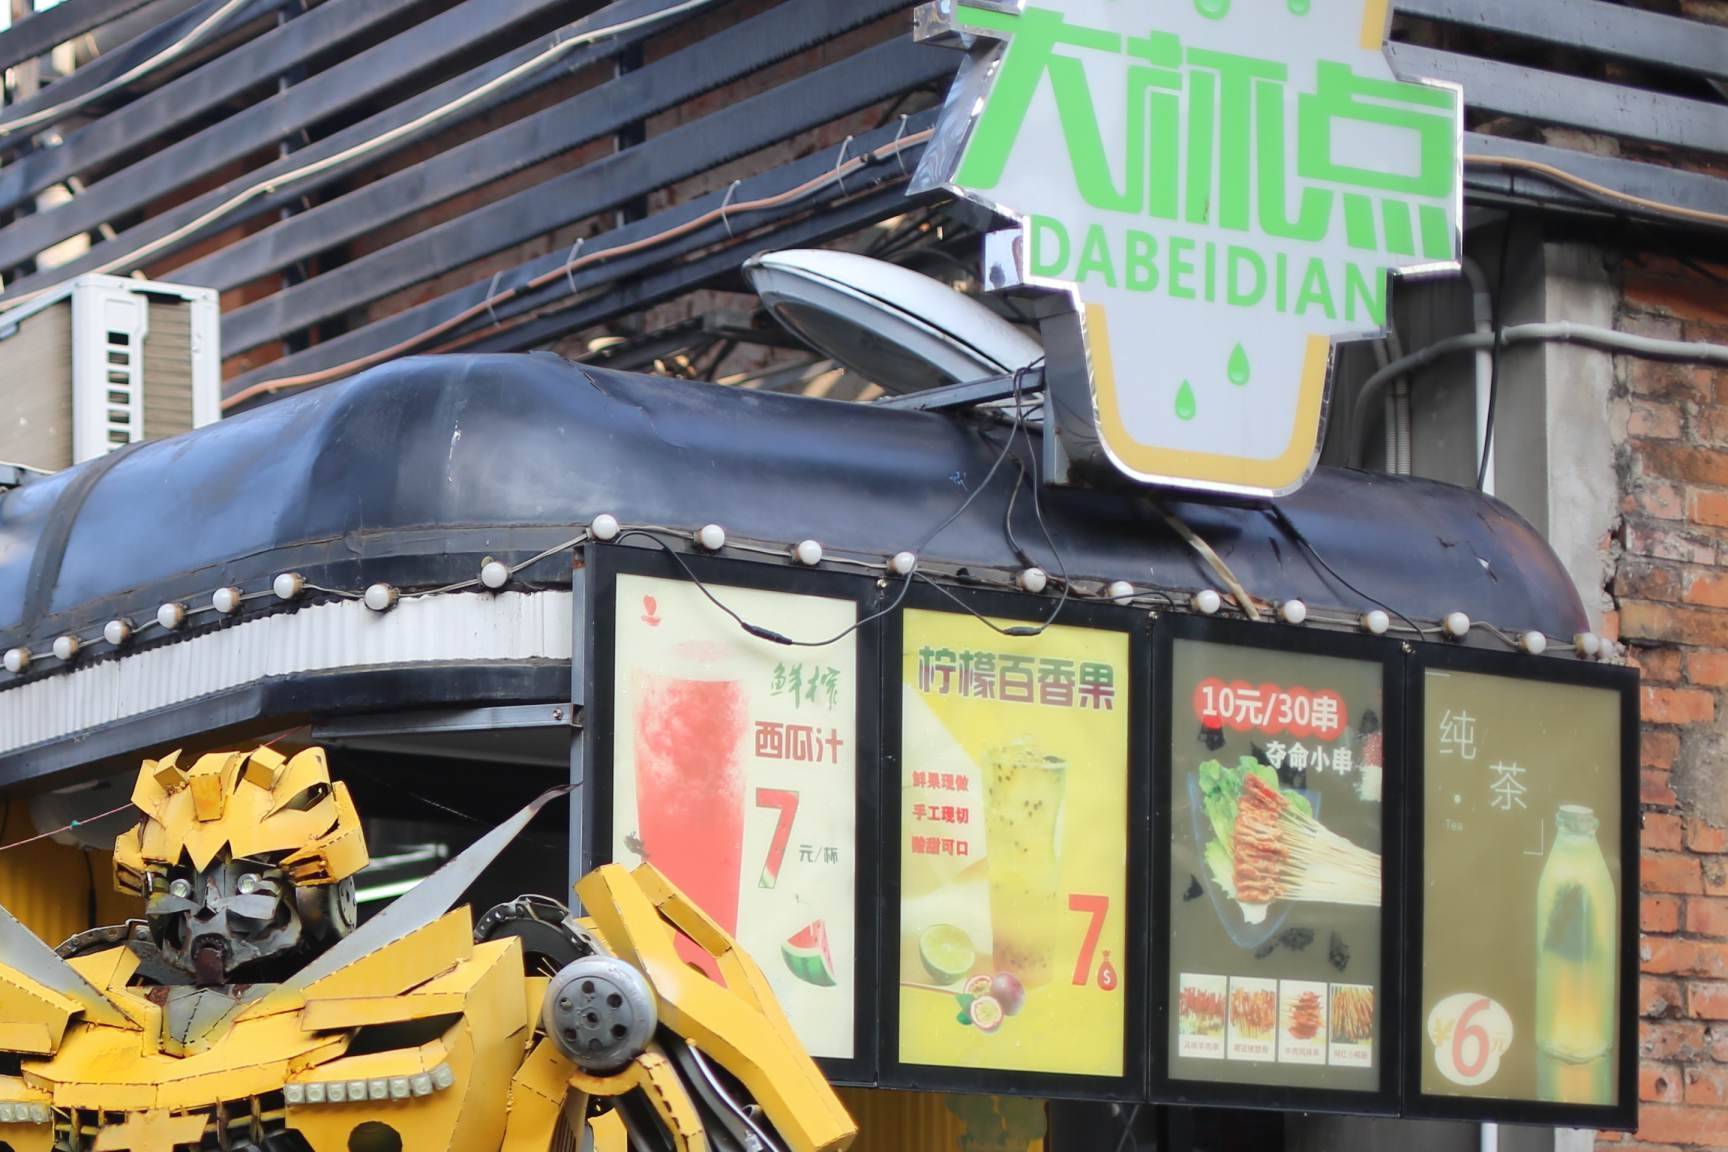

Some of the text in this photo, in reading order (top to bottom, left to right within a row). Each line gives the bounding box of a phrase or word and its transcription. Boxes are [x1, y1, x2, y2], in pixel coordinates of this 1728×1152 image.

[1029, 214, 1387, 326] DABEIDIAN
[770, 662, 840, 711] 鲜榨
[918, 646, 1115, 710] 柠檬百香果
[1202, 686, 1338, 732] 10元/30串
[754, 720, 844, 764] 西瓜汁
[1266, 740, 1353, 775] 夺命小串
[912, 804, 969, 824] 手工现切
[1068, 893, 1109, 986] 7
